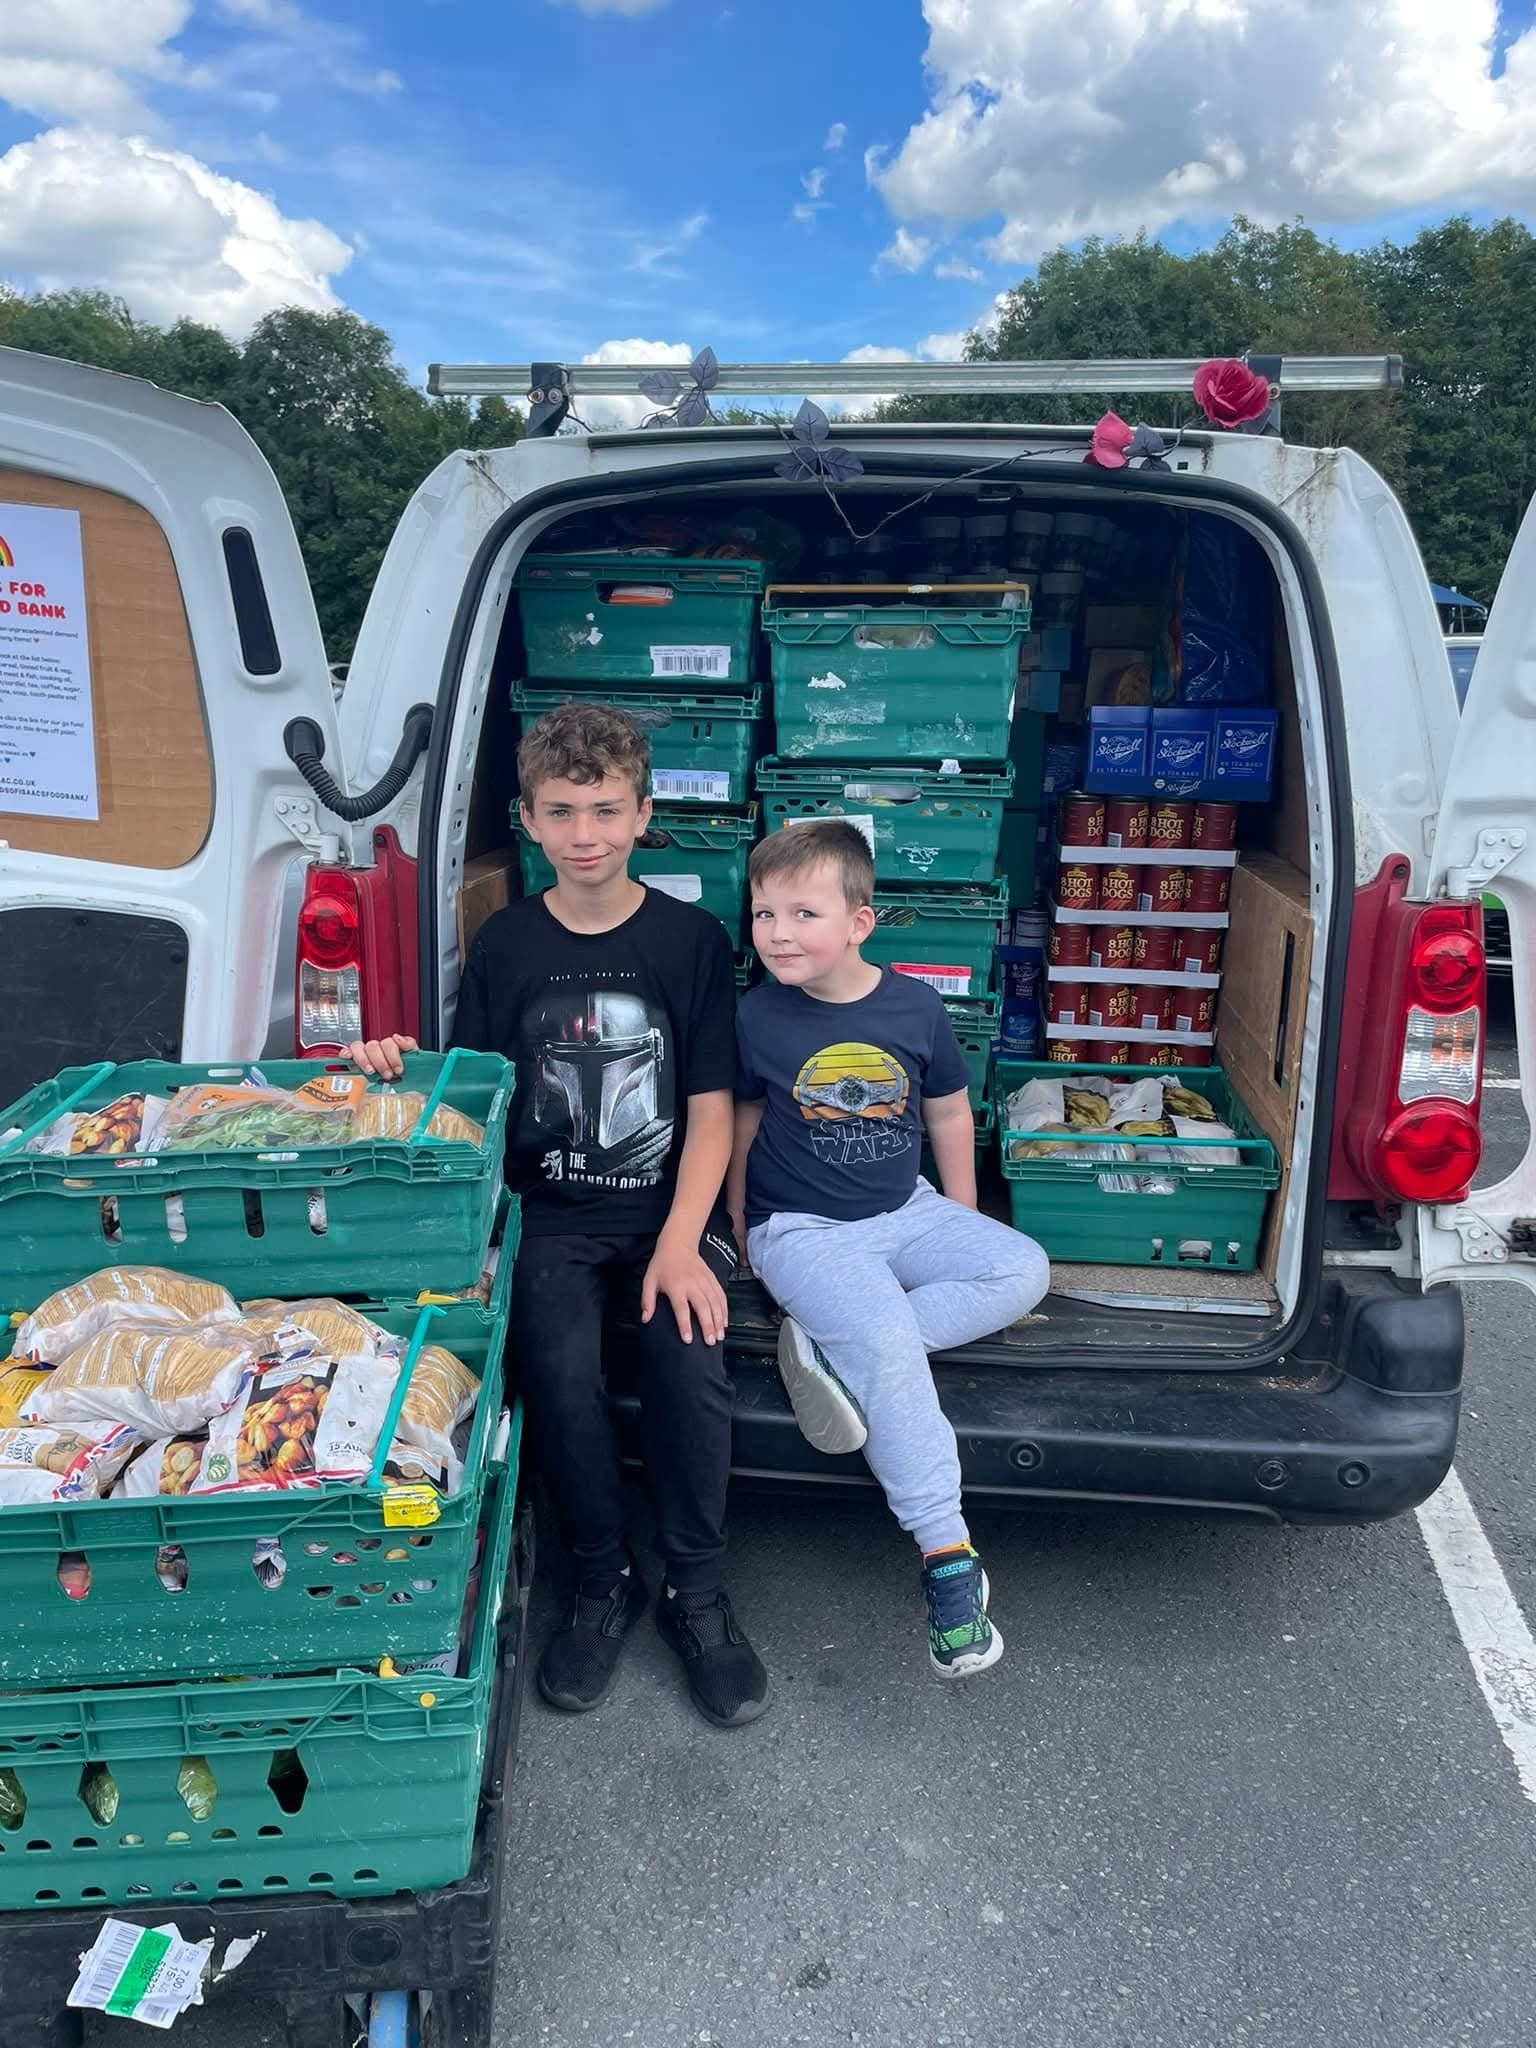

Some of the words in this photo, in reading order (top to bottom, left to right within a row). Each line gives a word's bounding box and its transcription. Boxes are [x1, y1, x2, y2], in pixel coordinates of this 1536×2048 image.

[9, 581, 46, 598] FOR
[18, 601, 66, 619] BANK
[1158, 818, 1184, 828] HOT
[1151, 828, 1183, 839] DOGS
[1067, 878, 1093, 888] HOT
[1109, 878, 1135, 889] HOT
[1061, 887, 1092, 898] DOGS
[1103, 888, 1133, 899] DOGS
[1053, 1053, 1078, 1063] HOT
[568, 1151, 588, 1170] THE
